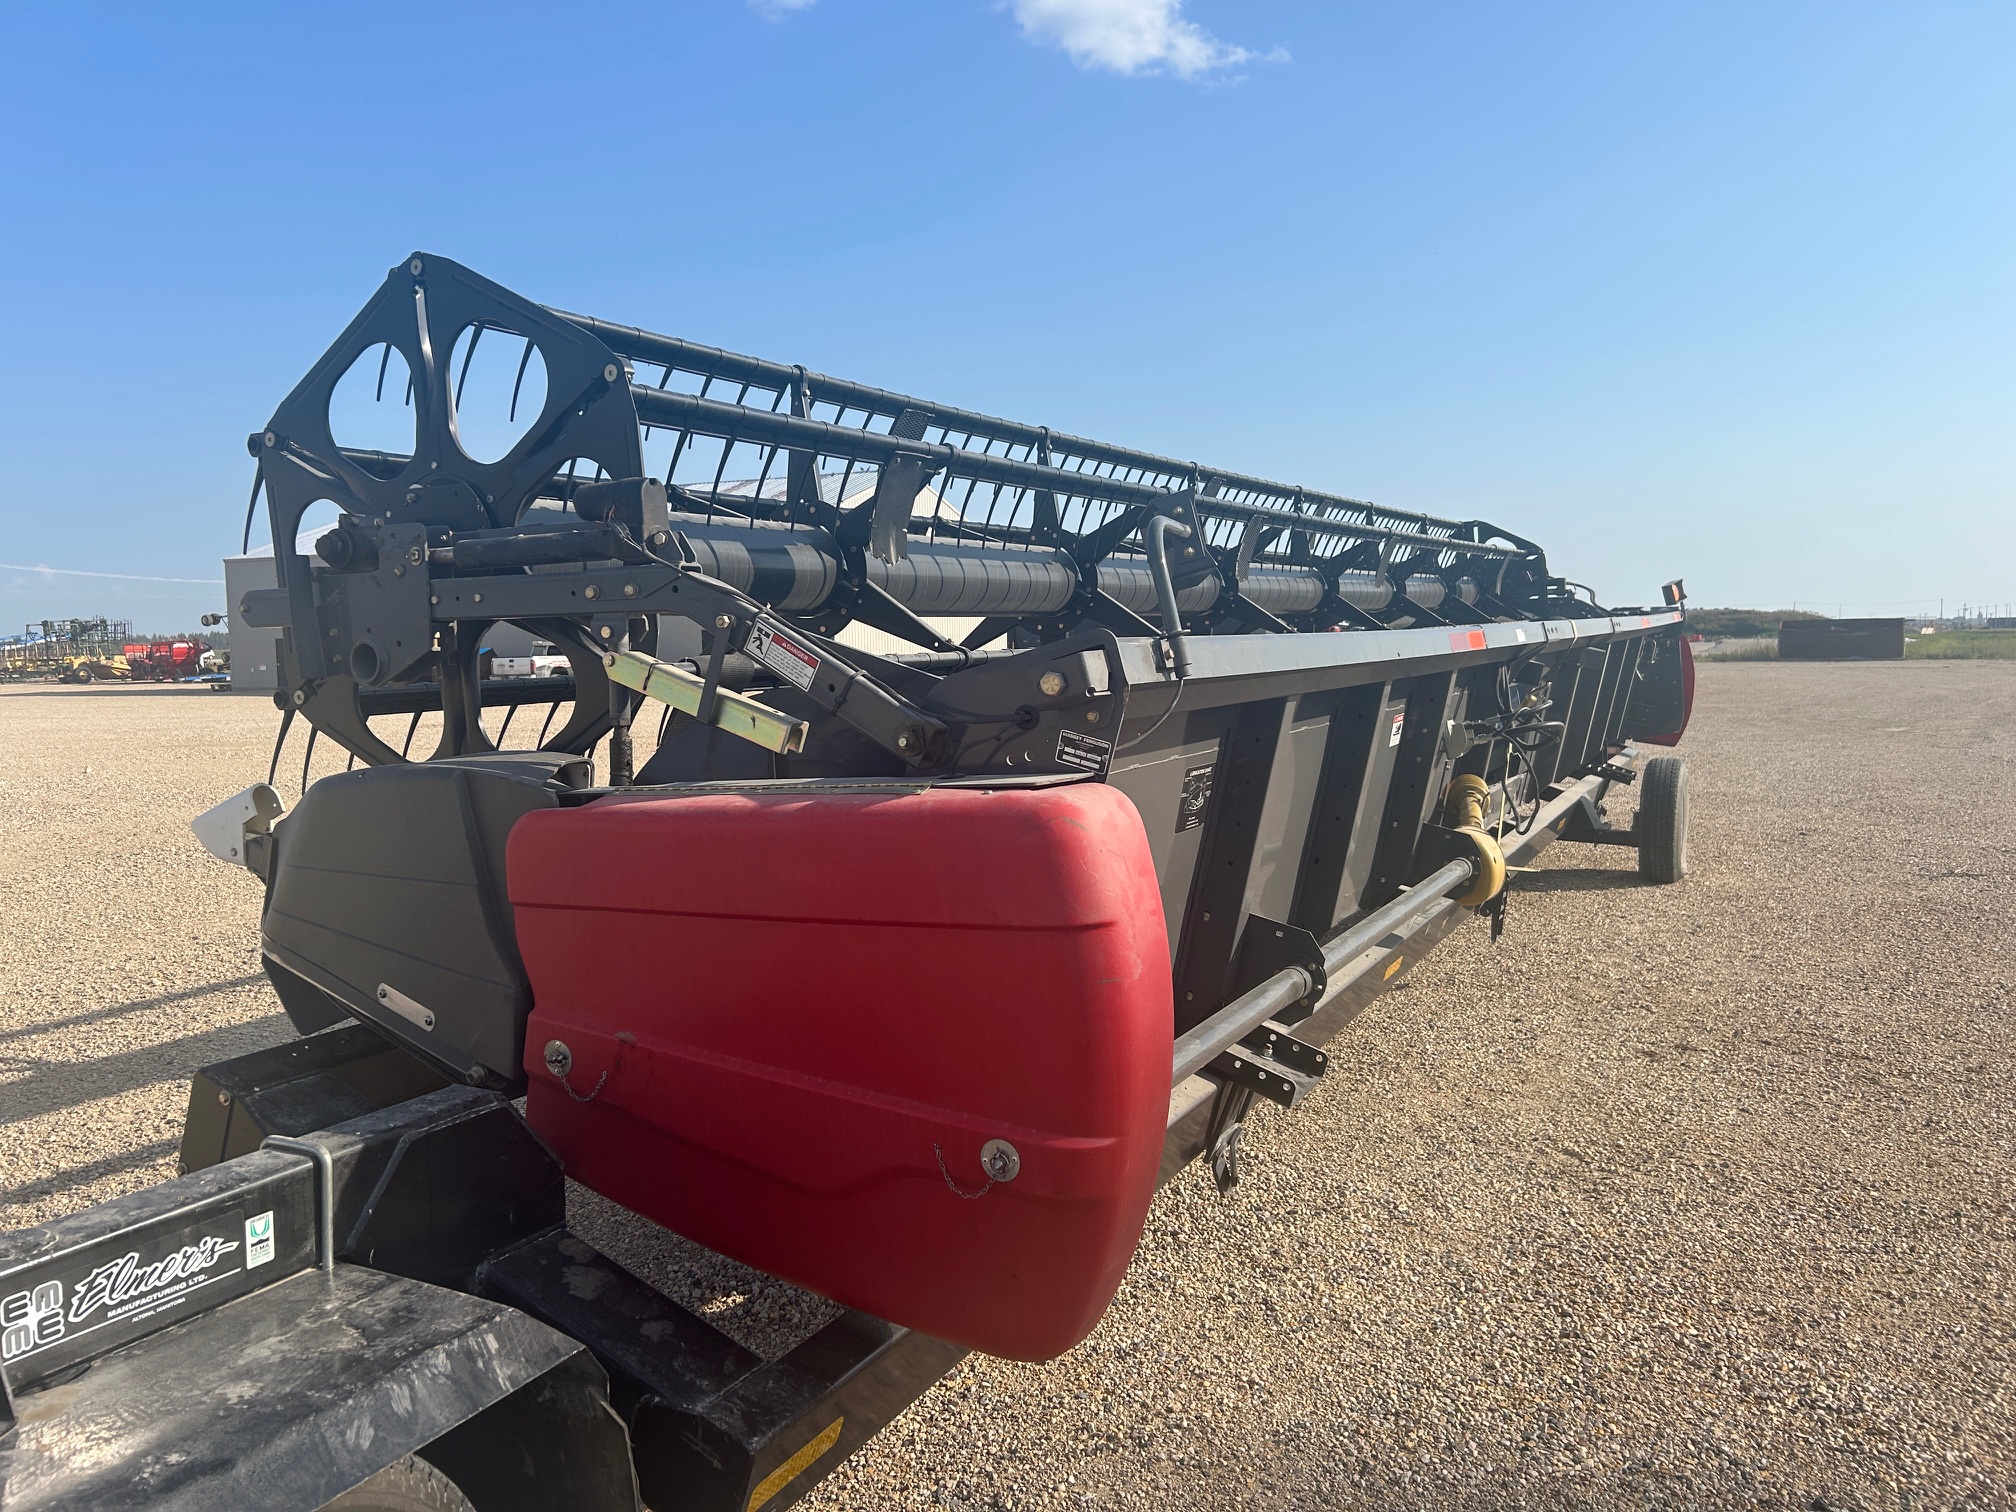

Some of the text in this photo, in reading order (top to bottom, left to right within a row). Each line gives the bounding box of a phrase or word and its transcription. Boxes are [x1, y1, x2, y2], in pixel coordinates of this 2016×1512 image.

[786, 644, 809, 661] DANGER
[1063, 732, 1083, 742] MASSEY
[1083, 737, 1110, 749] FERGUSON
[68, 1236, 240, 1323] Elmer's
[107, 1274, 208, 1319] MANUFACTURING LTD.
[132, 1297, 186, 1323] ALTONA, MANITOBA
